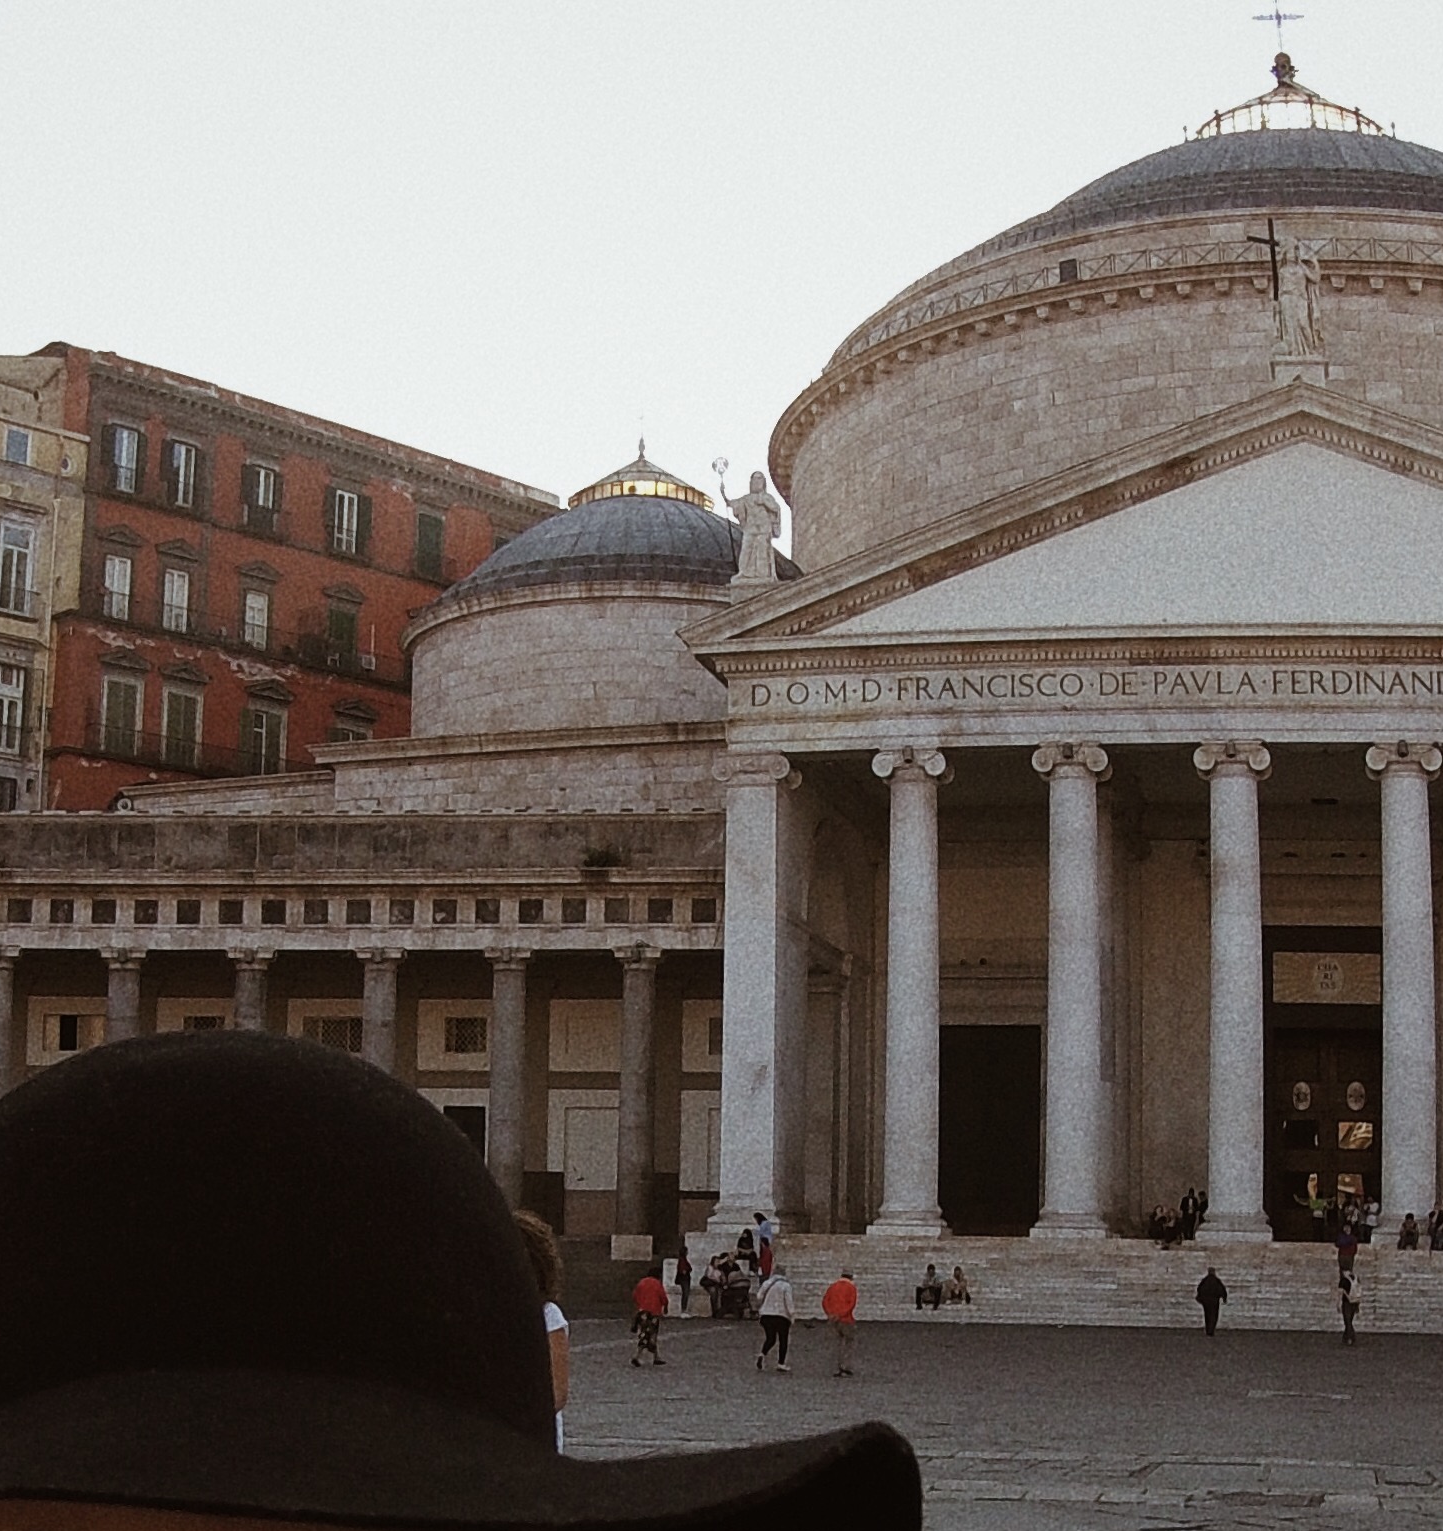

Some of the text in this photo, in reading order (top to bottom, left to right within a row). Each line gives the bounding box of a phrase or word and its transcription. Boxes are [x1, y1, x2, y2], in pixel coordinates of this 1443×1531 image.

[896, 672, 1085, 701] FRANCISCO
[1098, 670, 1139, 697] DE
[1153, 669, 1259, 696] PAVLA
